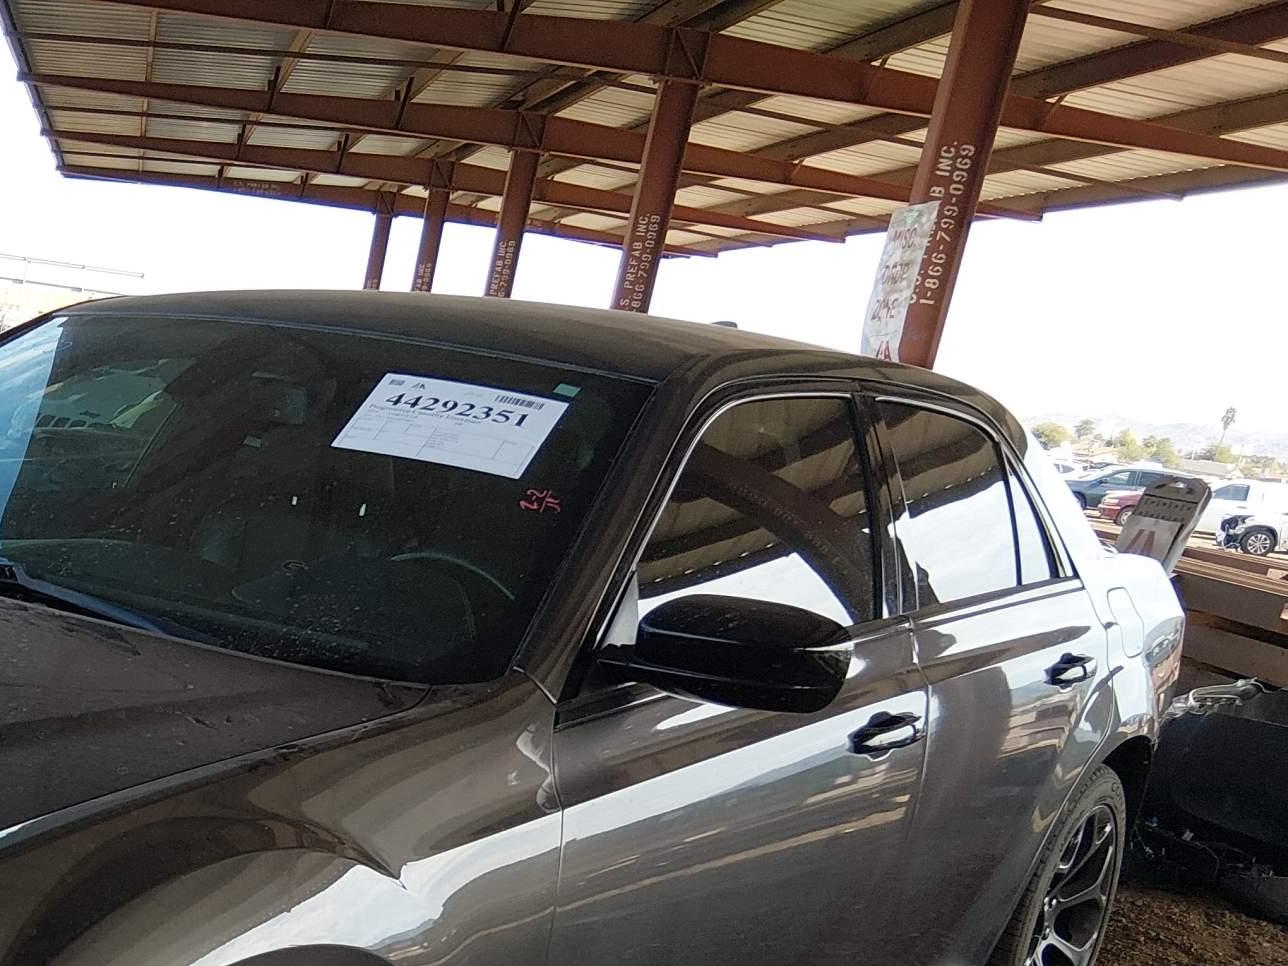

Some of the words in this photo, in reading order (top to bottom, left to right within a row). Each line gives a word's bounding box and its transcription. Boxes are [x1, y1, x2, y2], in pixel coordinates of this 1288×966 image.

[935, 141, 958, 177] INC.
[624, 241, 642, 289] PREFAB
[635, 213, 651, 236] INC.
[919, 144, 976, 305] 1-866-799-0969
[631, 215, 661, 312] -866-799-0969
[386, 393, 529, 427] 44292351
